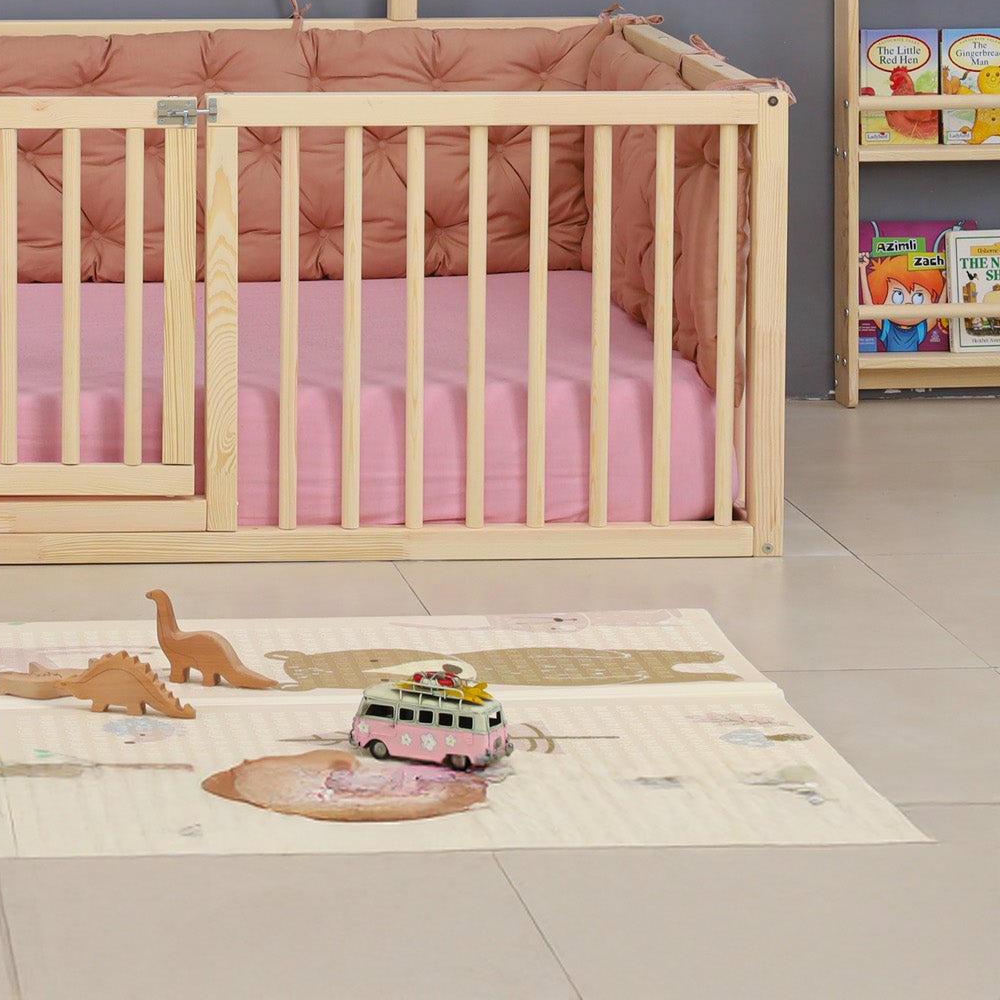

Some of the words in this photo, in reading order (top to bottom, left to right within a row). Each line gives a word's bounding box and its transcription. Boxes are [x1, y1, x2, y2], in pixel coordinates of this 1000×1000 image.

[877, 46, 894, 55] The
[897, 45, 921, 55] Little
[972, 41, 987, 49] The
[955, 49, 1000, 59] Gingerbrea
[879, 55, 897, 65] Red
[900, 55, 919, 65] Hen
[971, 58, 989, 66] Man
[876, 239, 917, 252] Azimli
[960, 257, 988, 269] THE
